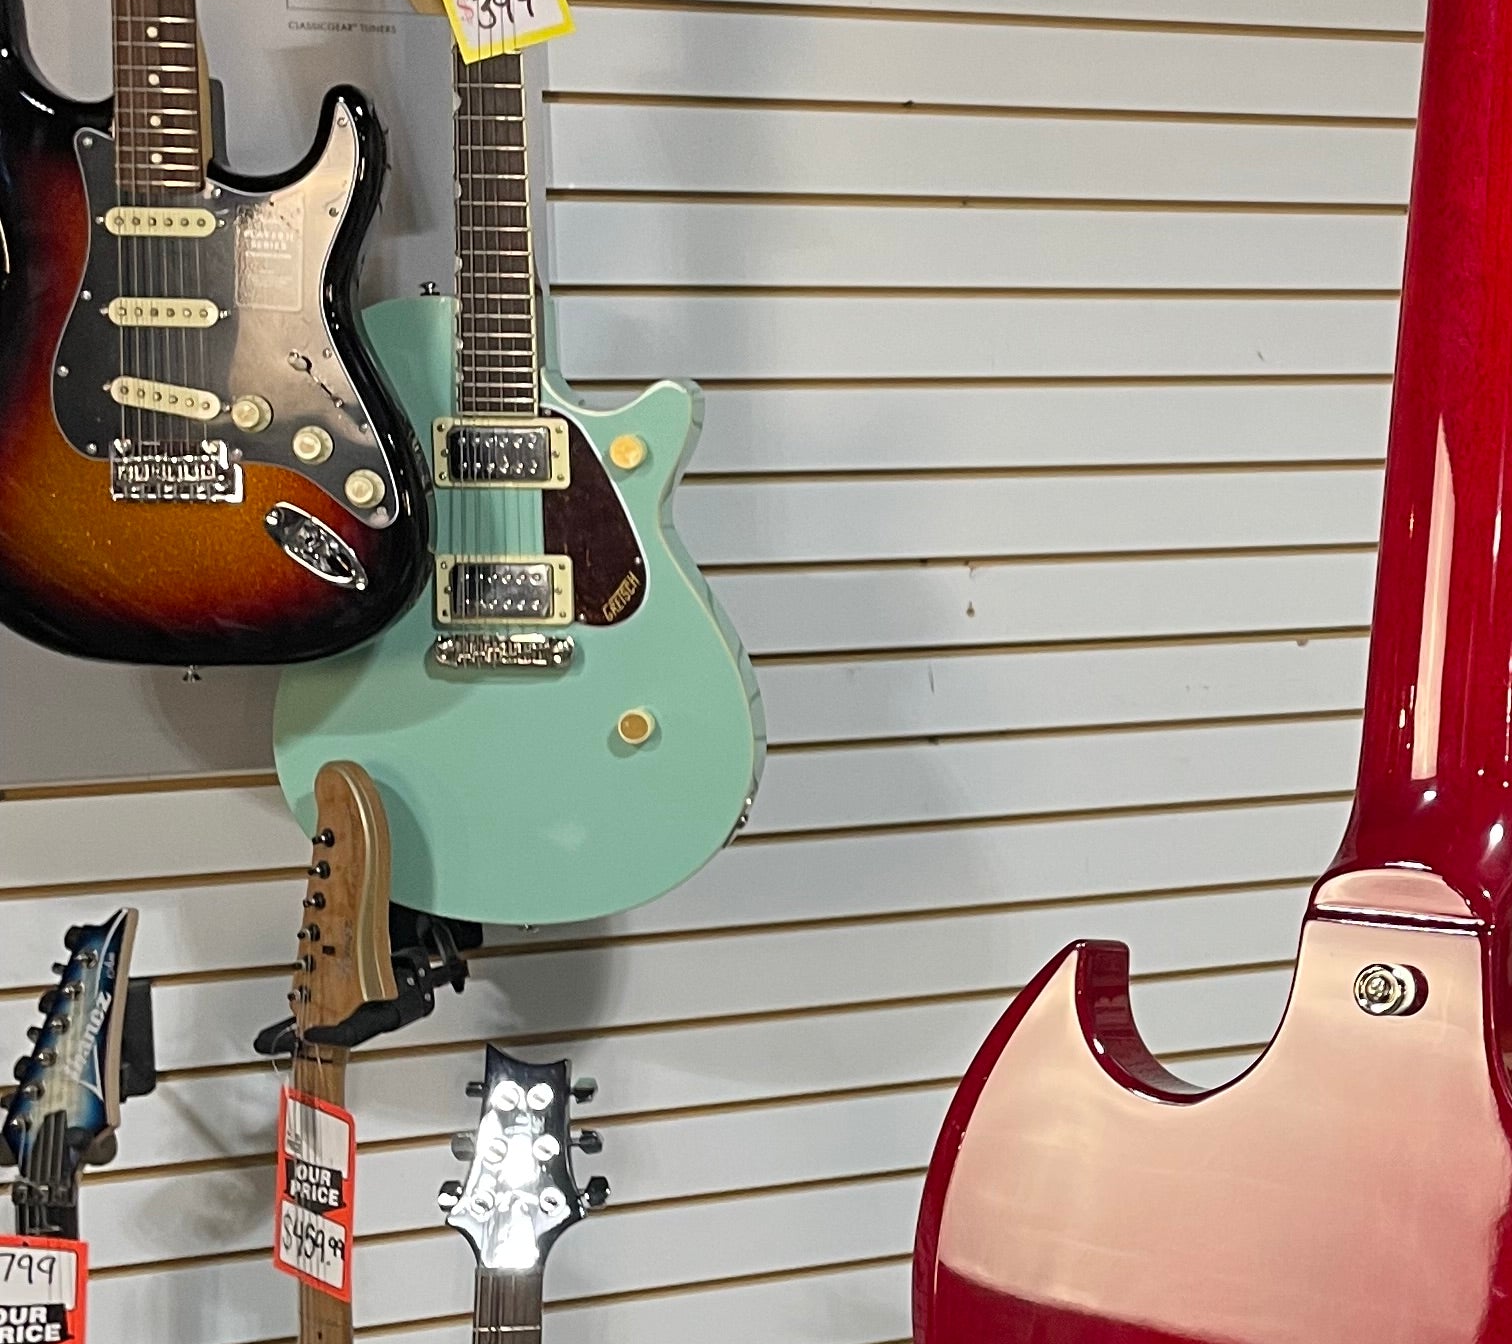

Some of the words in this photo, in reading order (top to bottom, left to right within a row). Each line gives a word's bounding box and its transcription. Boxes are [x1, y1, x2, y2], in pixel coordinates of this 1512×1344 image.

[602, 570, 640, 622] GRETSCH
[295, 1164, 332, 1188] OUR
[290, 1179, 340, 1207] PRICE
